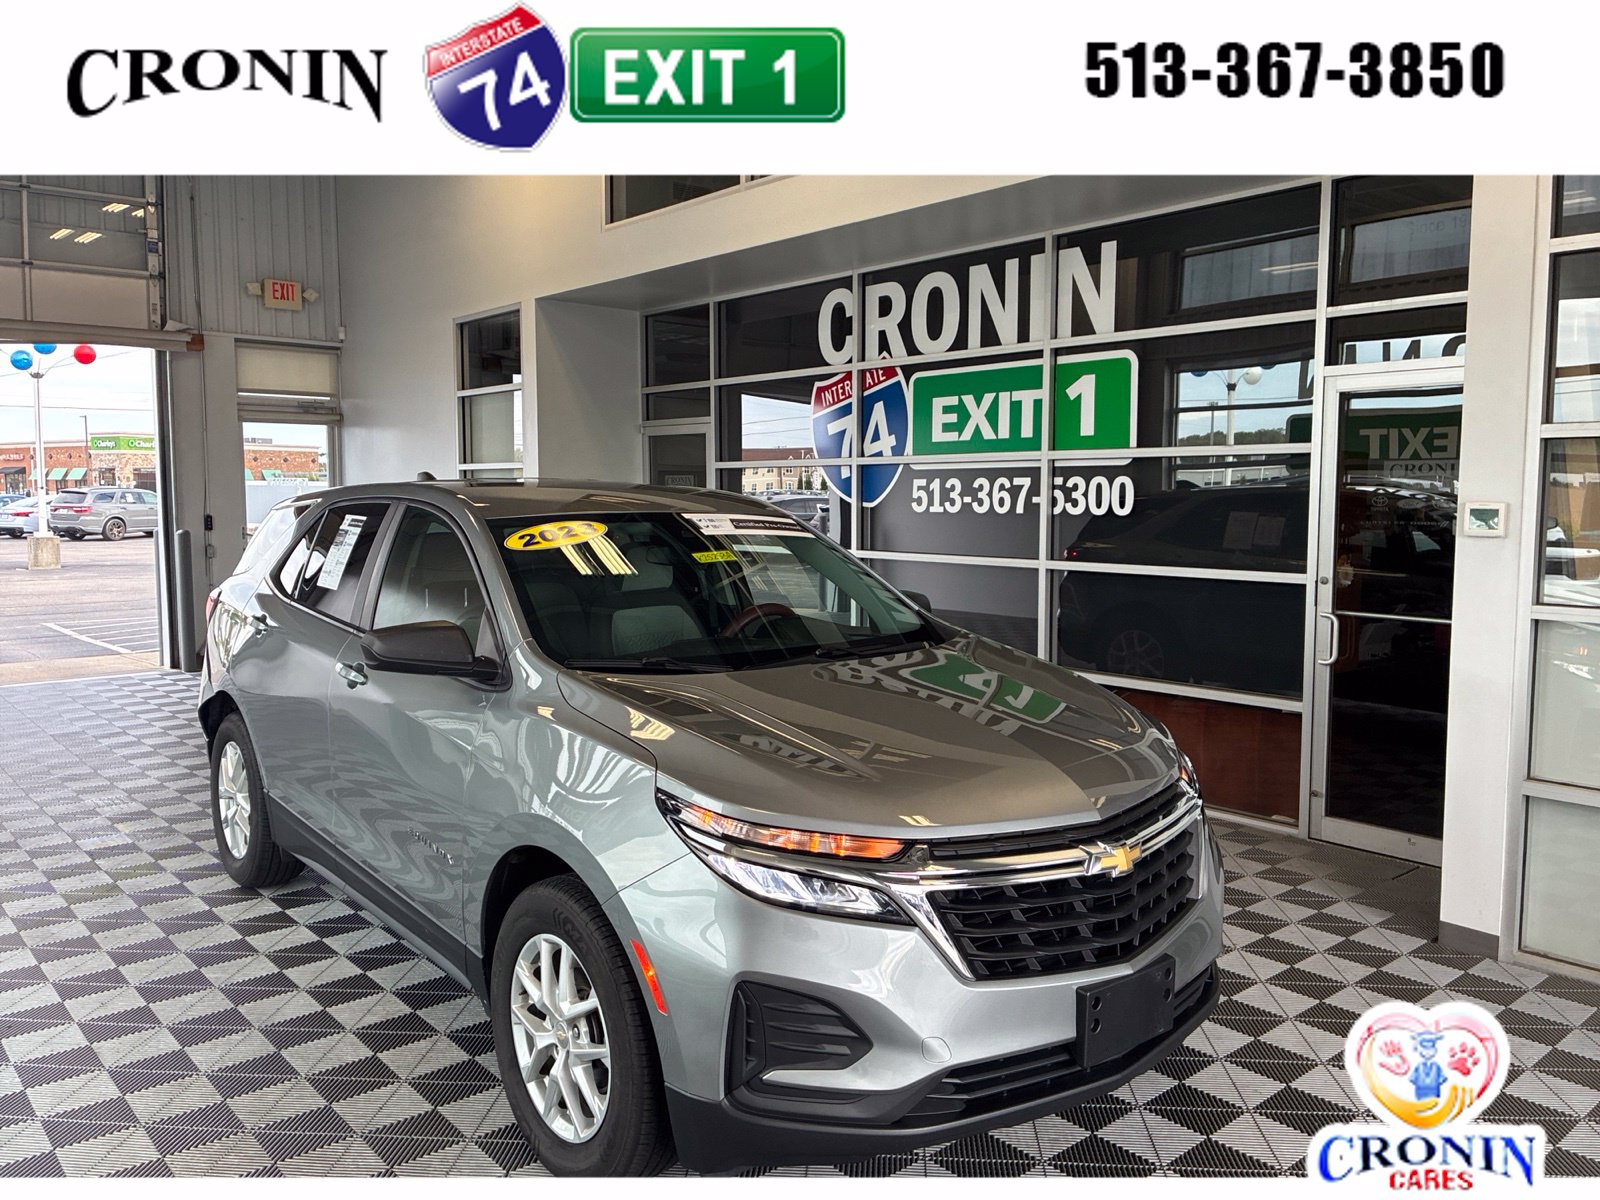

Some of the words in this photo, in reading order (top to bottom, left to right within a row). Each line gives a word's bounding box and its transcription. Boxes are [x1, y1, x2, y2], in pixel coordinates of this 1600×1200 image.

[271, 281, 296, 302] EXIT
[818, 240, 1117, 365] CRONIN
[932, 388, 1043, 443] EXIT
[1065, 373, 1096, 437] 1
[827, 400, 896, 480] 74
[911, 475, 1135, 516] 513-367-5300
[518, 523, 600, 548] 2023
